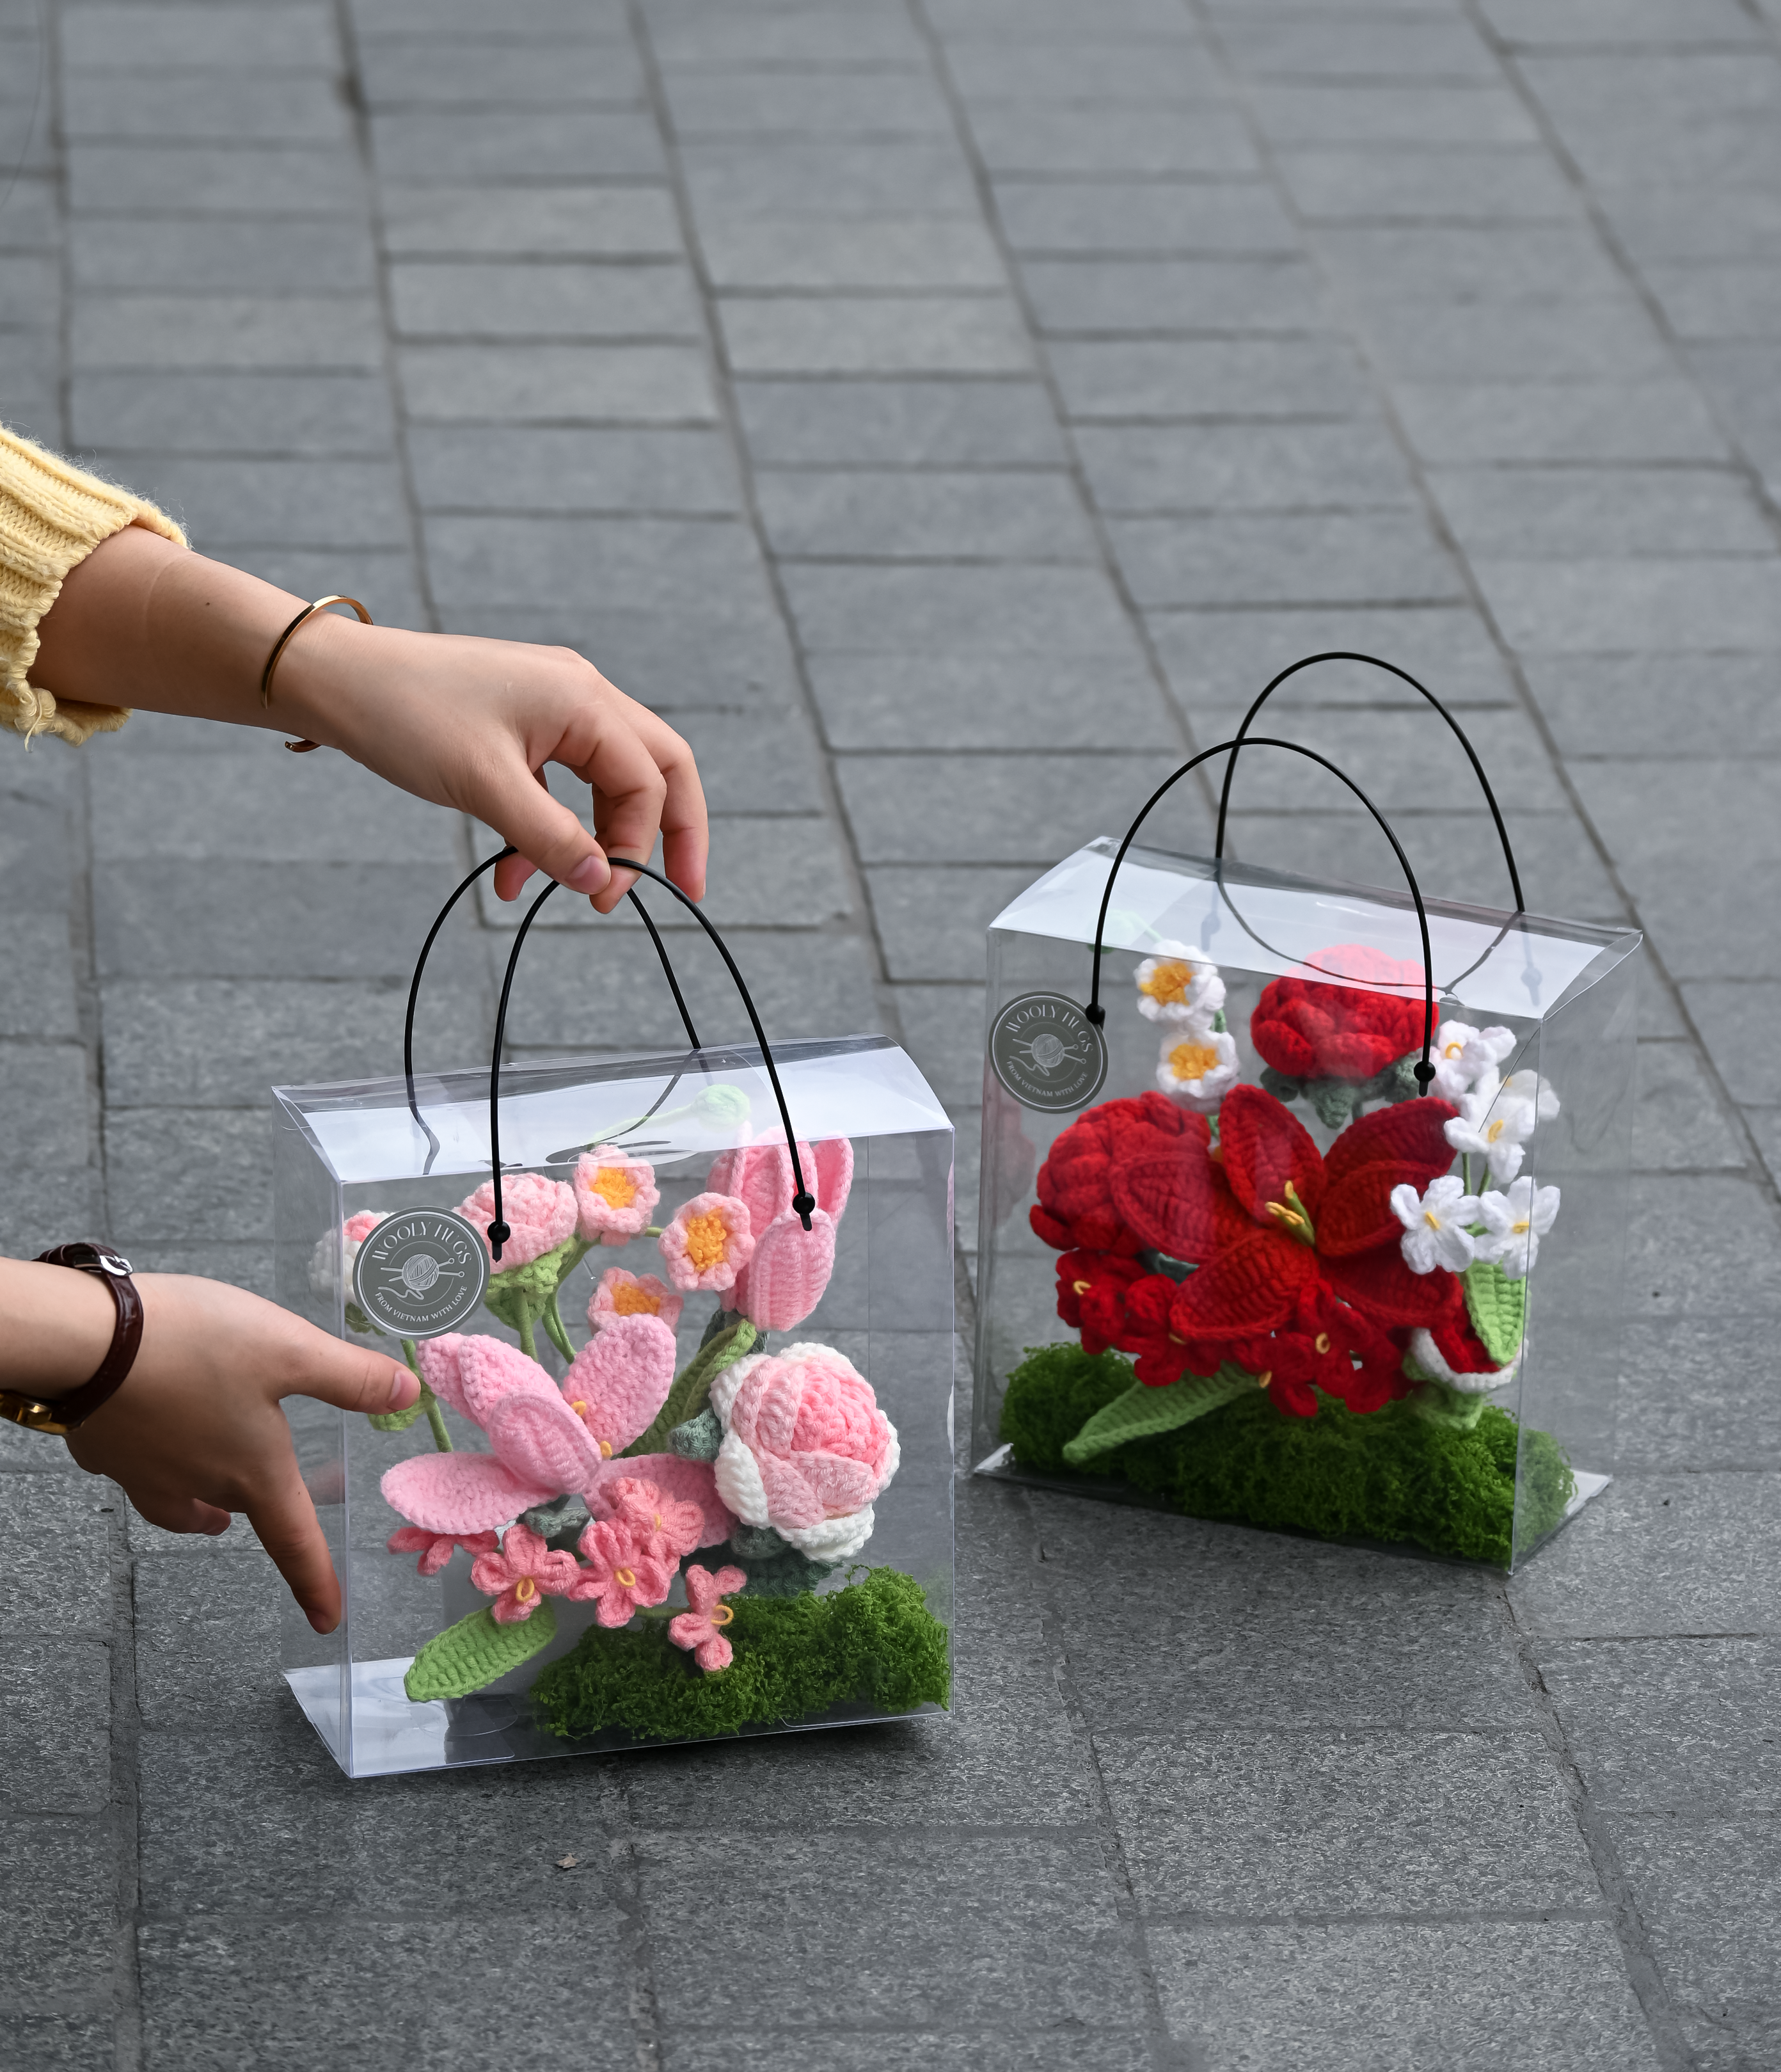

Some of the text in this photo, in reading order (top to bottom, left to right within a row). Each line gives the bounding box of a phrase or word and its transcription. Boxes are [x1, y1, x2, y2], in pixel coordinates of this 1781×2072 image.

[1006, 1005, 1093, 1052] WOOLY HUGS
[1007, 1060, 1088, 1097] FROM VIETNAM WITH LOVE
[372, 1222, 471, 1264] WOOLY HUGS
[375, 1286, 468, 1322] FROM VIETNAM WITH LOVE
